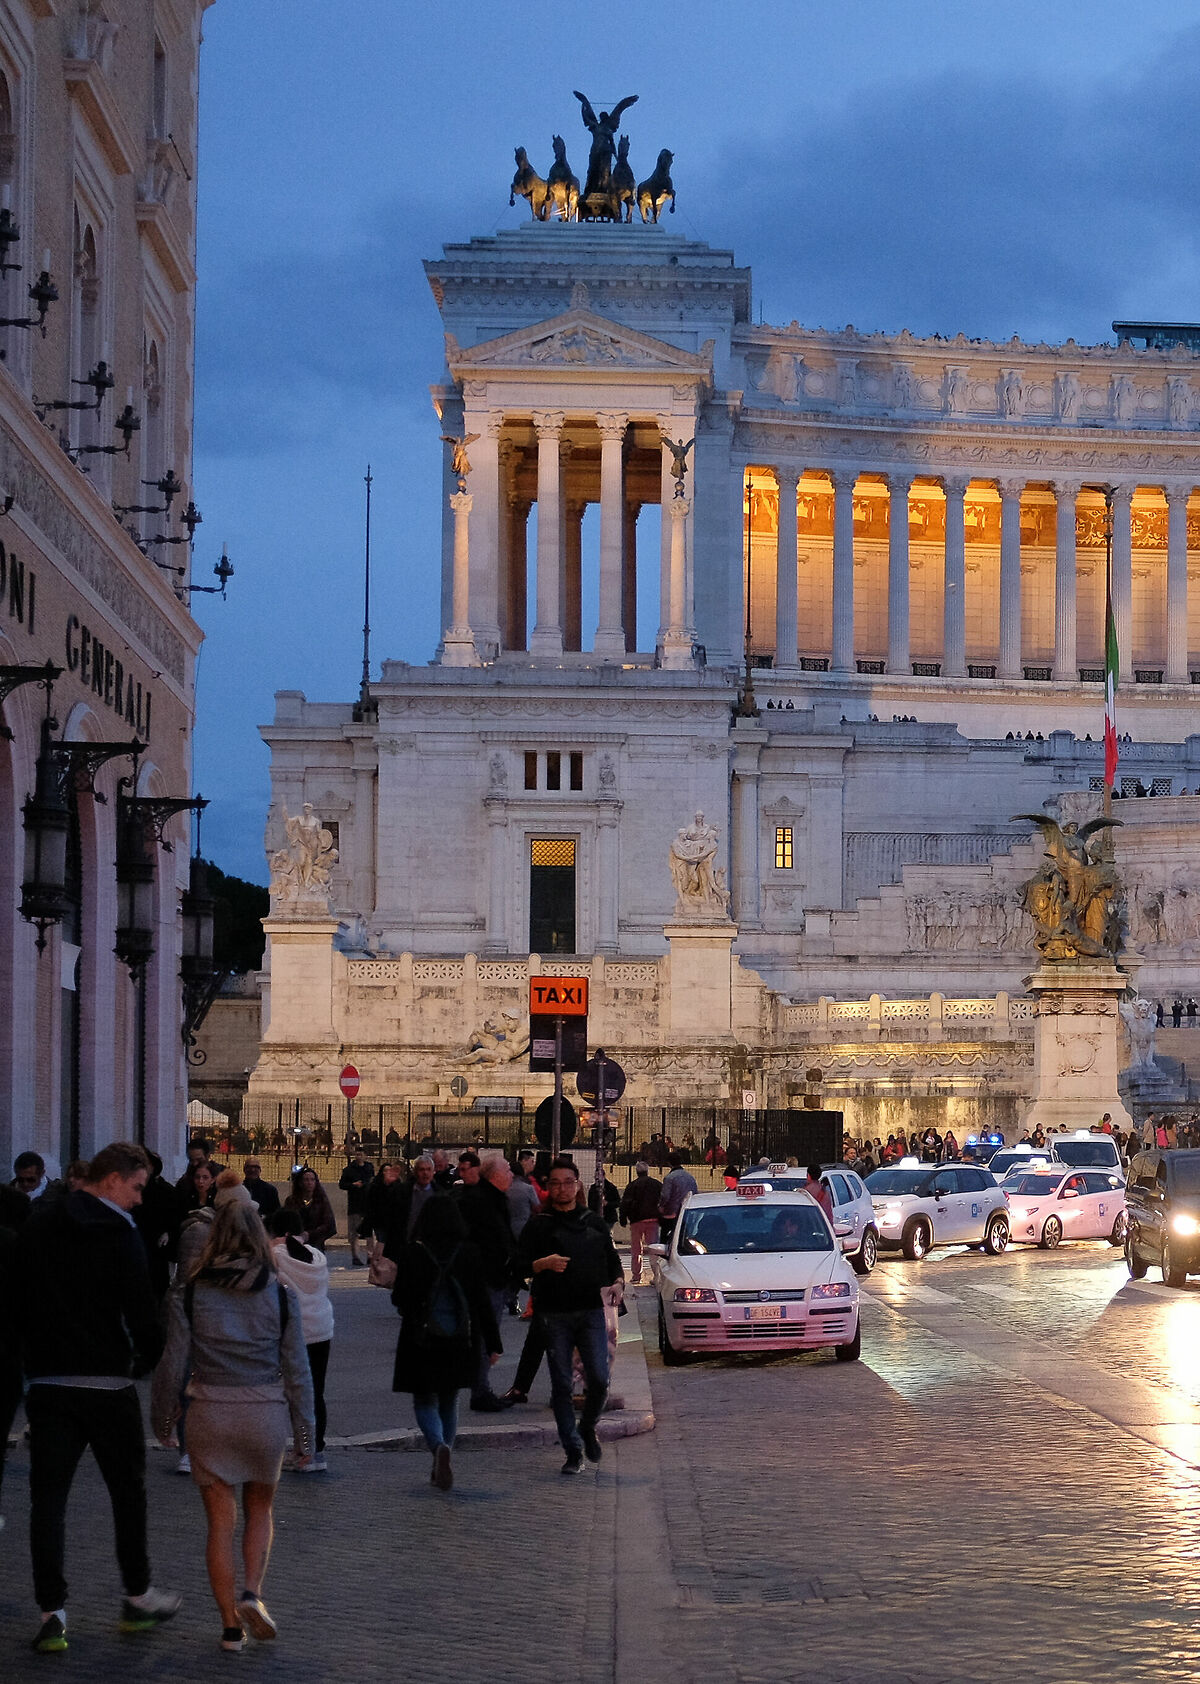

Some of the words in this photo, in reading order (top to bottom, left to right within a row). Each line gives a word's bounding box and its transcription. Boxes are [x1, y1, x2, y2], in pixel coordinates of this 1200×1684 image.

[66, 613, 151, 742] GENERALI
[533, 987, 582, 1004] TAXI
[739, 1187, 763, 1195] TAXI
